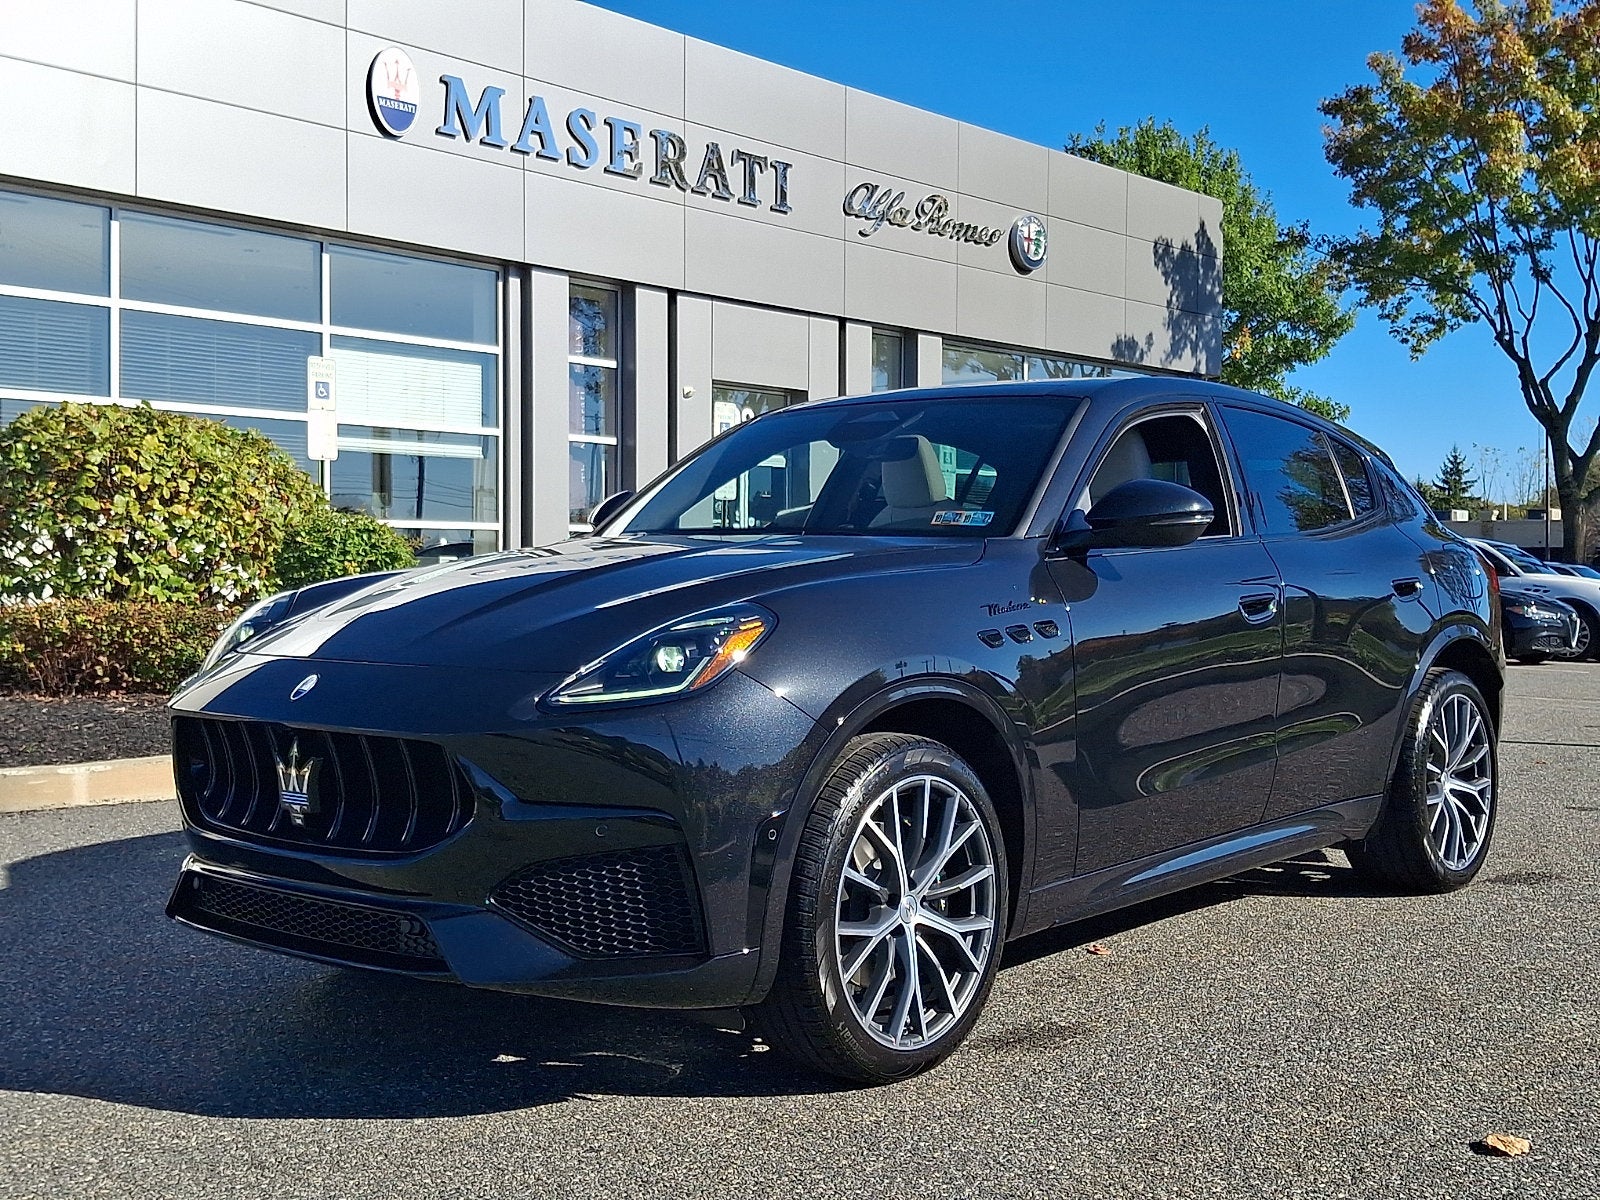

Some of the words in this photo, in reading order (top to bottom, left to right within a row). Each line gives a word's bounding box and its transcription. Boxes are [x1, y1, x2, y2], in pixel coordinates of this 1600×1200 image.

[379, 97, 416, 114] MASERATI
[435, 74, 793, 215] MASERATI
[842, 182, 914, 238] Alfa
[911, 194, 1004, 247] Romeo
[980, 600, 1031, 617] Modena
